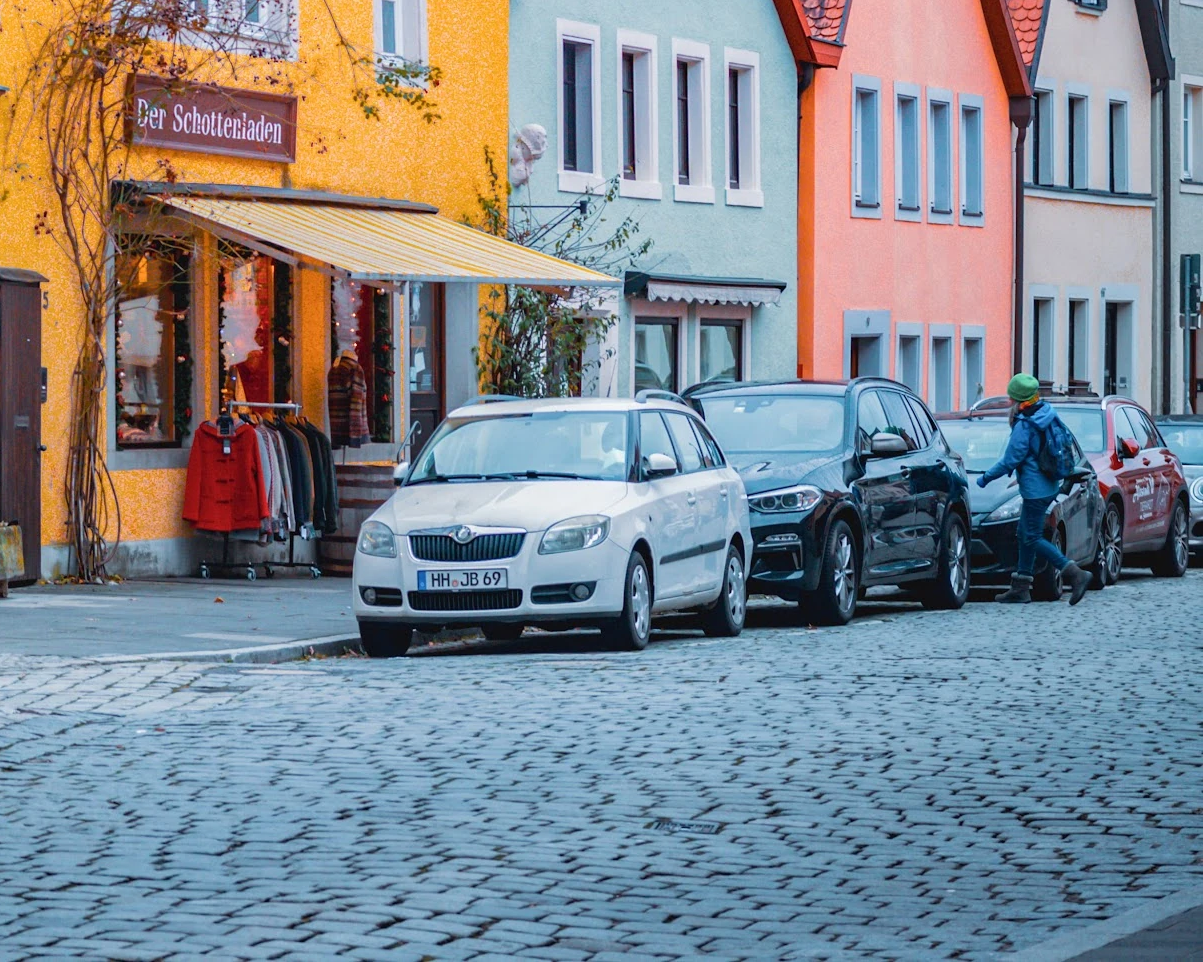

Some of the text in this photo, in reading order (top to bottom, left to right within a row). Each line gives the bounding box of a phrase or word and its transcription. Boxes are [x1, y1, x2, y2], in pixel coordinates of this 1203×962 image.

[137, 98, 282, 144] Der Schottenladen
[460, 572, 479, 587] JB
[483, 571, 501, 586] 69
